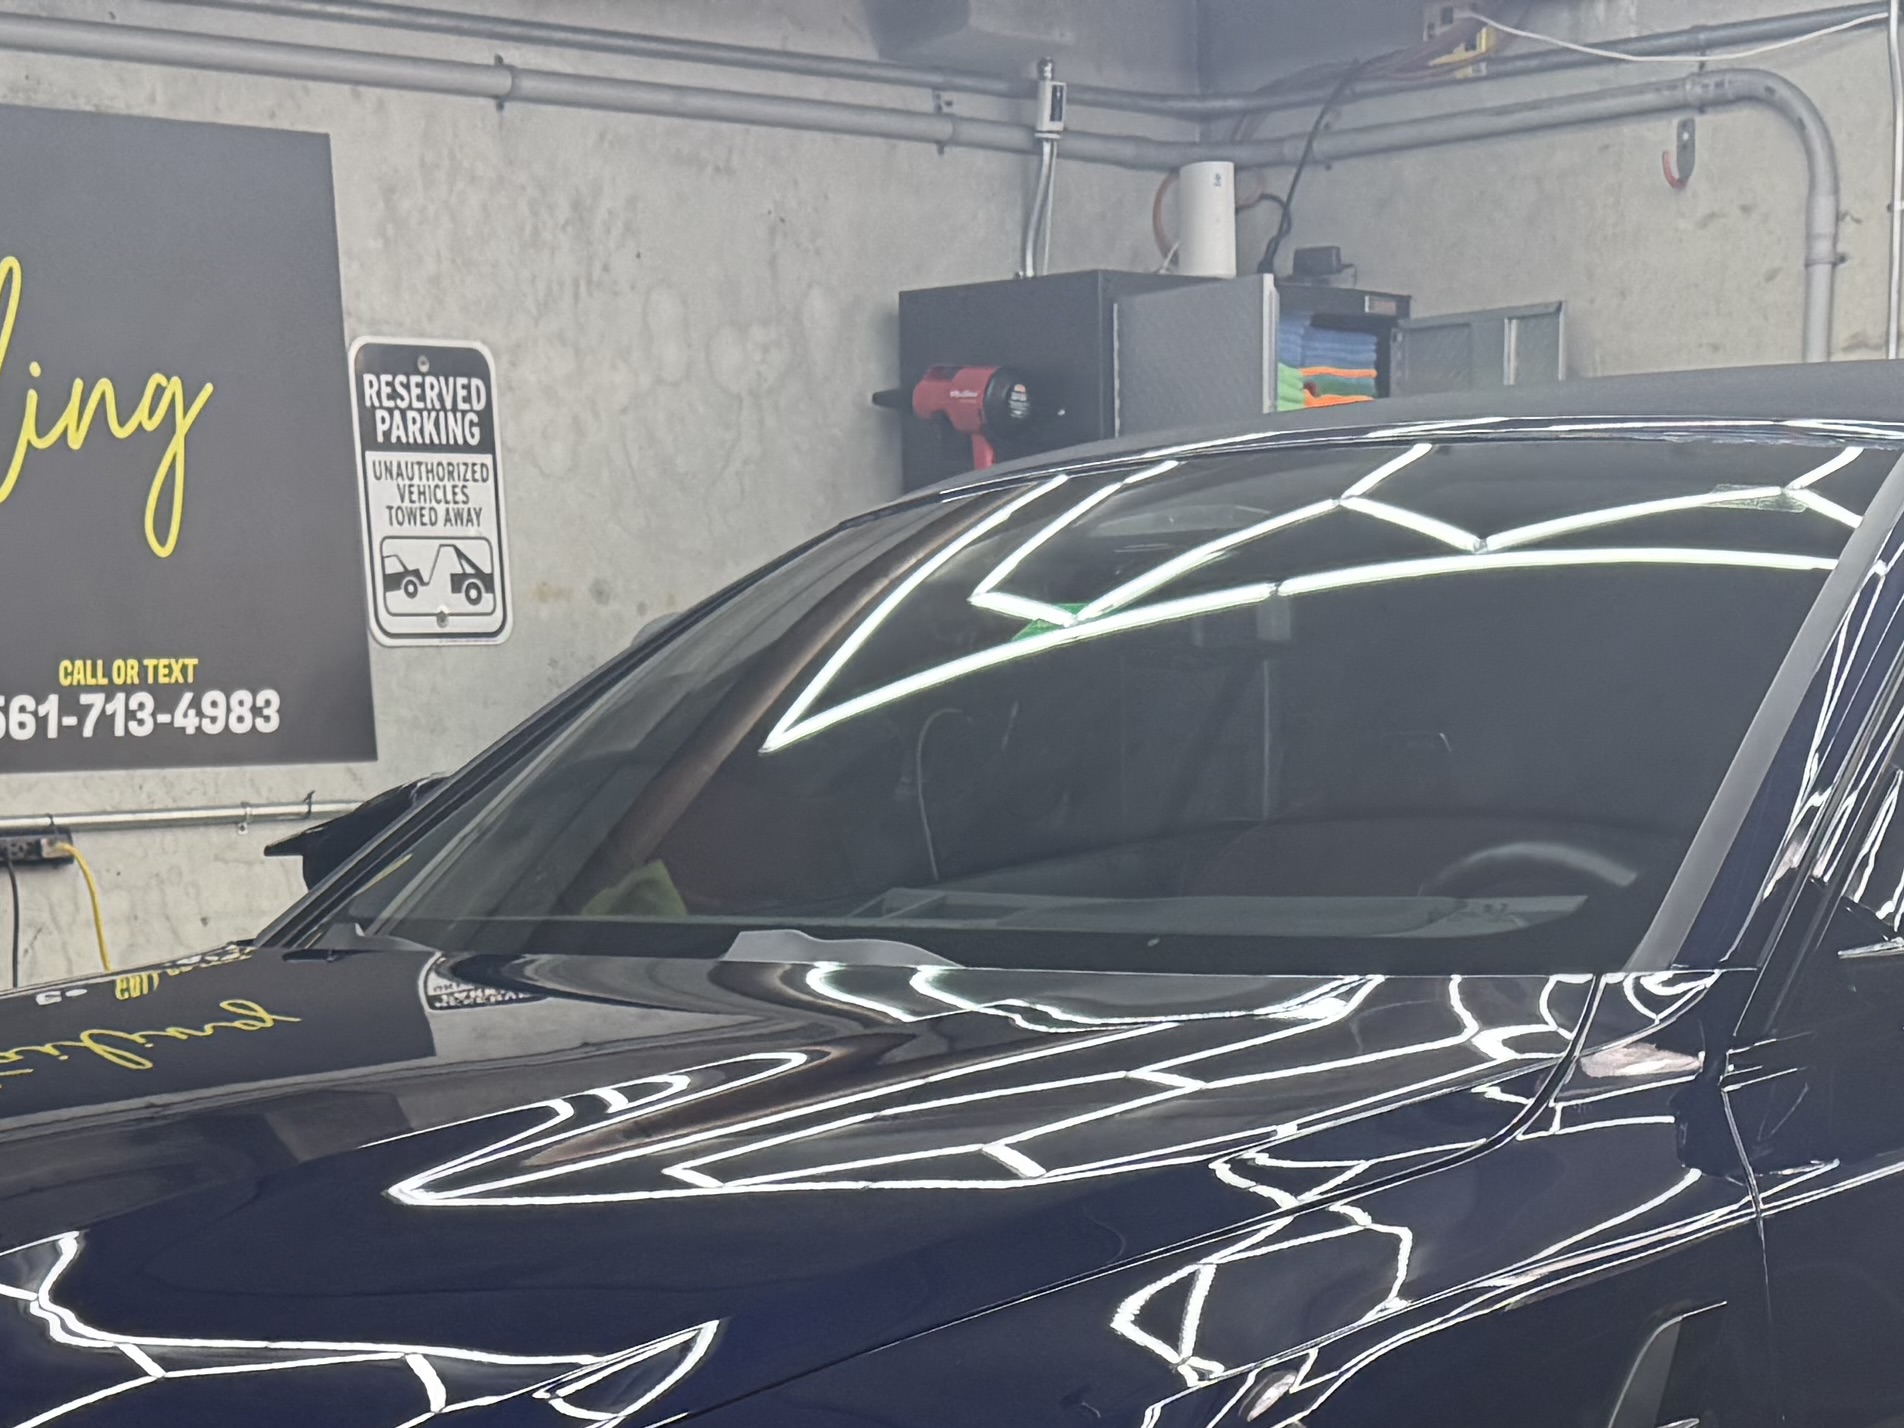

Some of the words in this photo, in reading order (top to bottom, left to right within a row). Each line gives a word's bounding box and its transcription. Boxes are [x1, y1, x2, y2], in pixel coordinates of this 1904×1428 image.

[362, 372, 487, 412] RESERVED
[374, 408, 481, 446] PARKING
[372, 459, 490, 484] UNAUTHORIZED
[396, 483, 471, 506] VEHICLES
[385, 505, 438, 528] TOWED
[443, 506, 483, 528] AWAY
[58, 658, 109, 687] CALL
[111, 658, 140, 686] OR
[143, 657, 199, 685] TEXT
